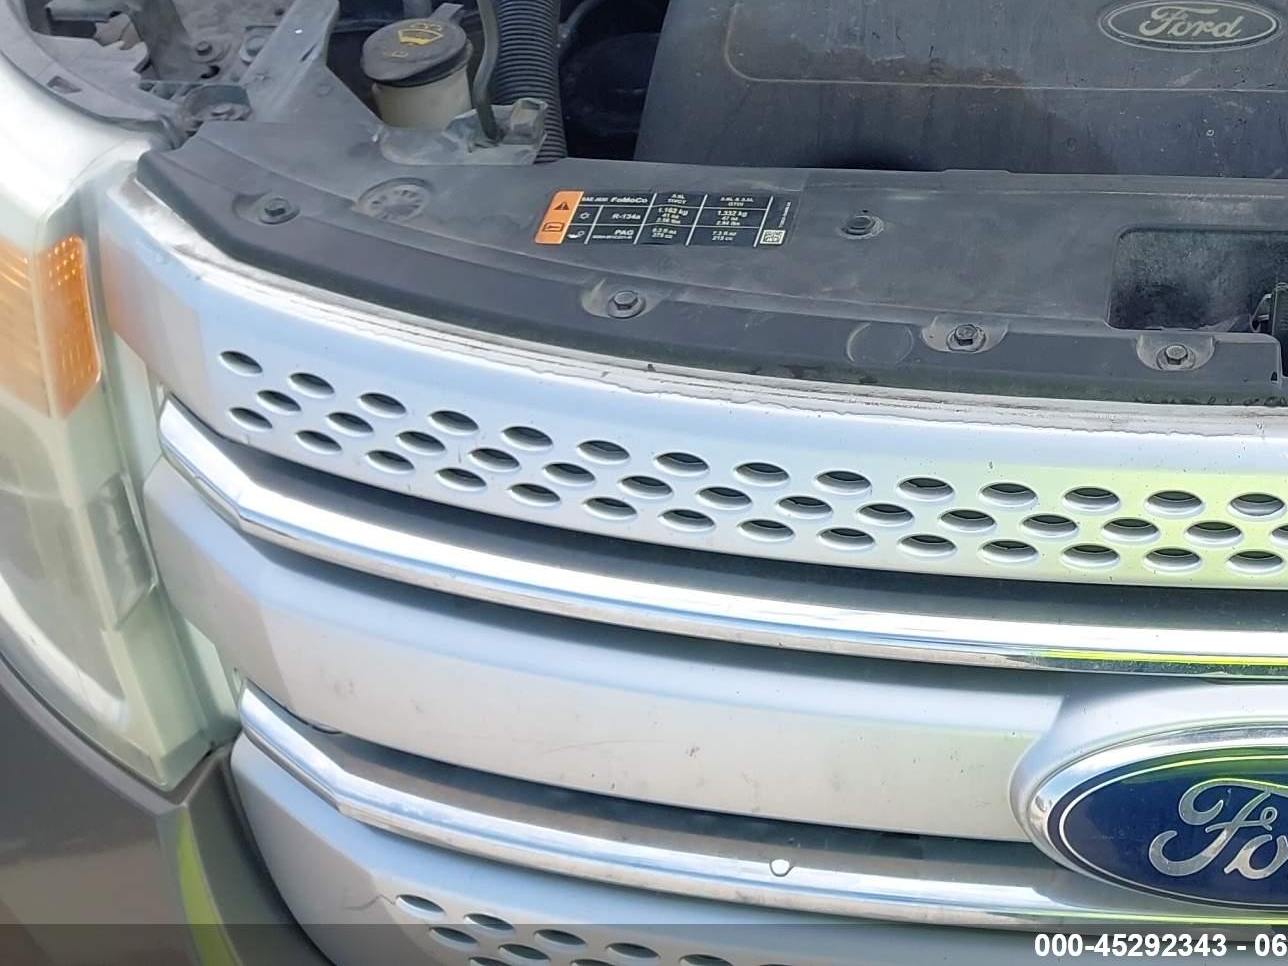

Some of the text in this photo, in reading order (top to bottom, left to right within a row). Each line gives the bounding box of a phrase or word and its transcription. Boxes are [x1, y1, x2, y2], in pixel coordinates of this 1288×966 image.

[1138, 5, 1244, 38] Ford
[610, 196, 648, 204] FoMoCo
[611, 212, 641, 220] R-134a
